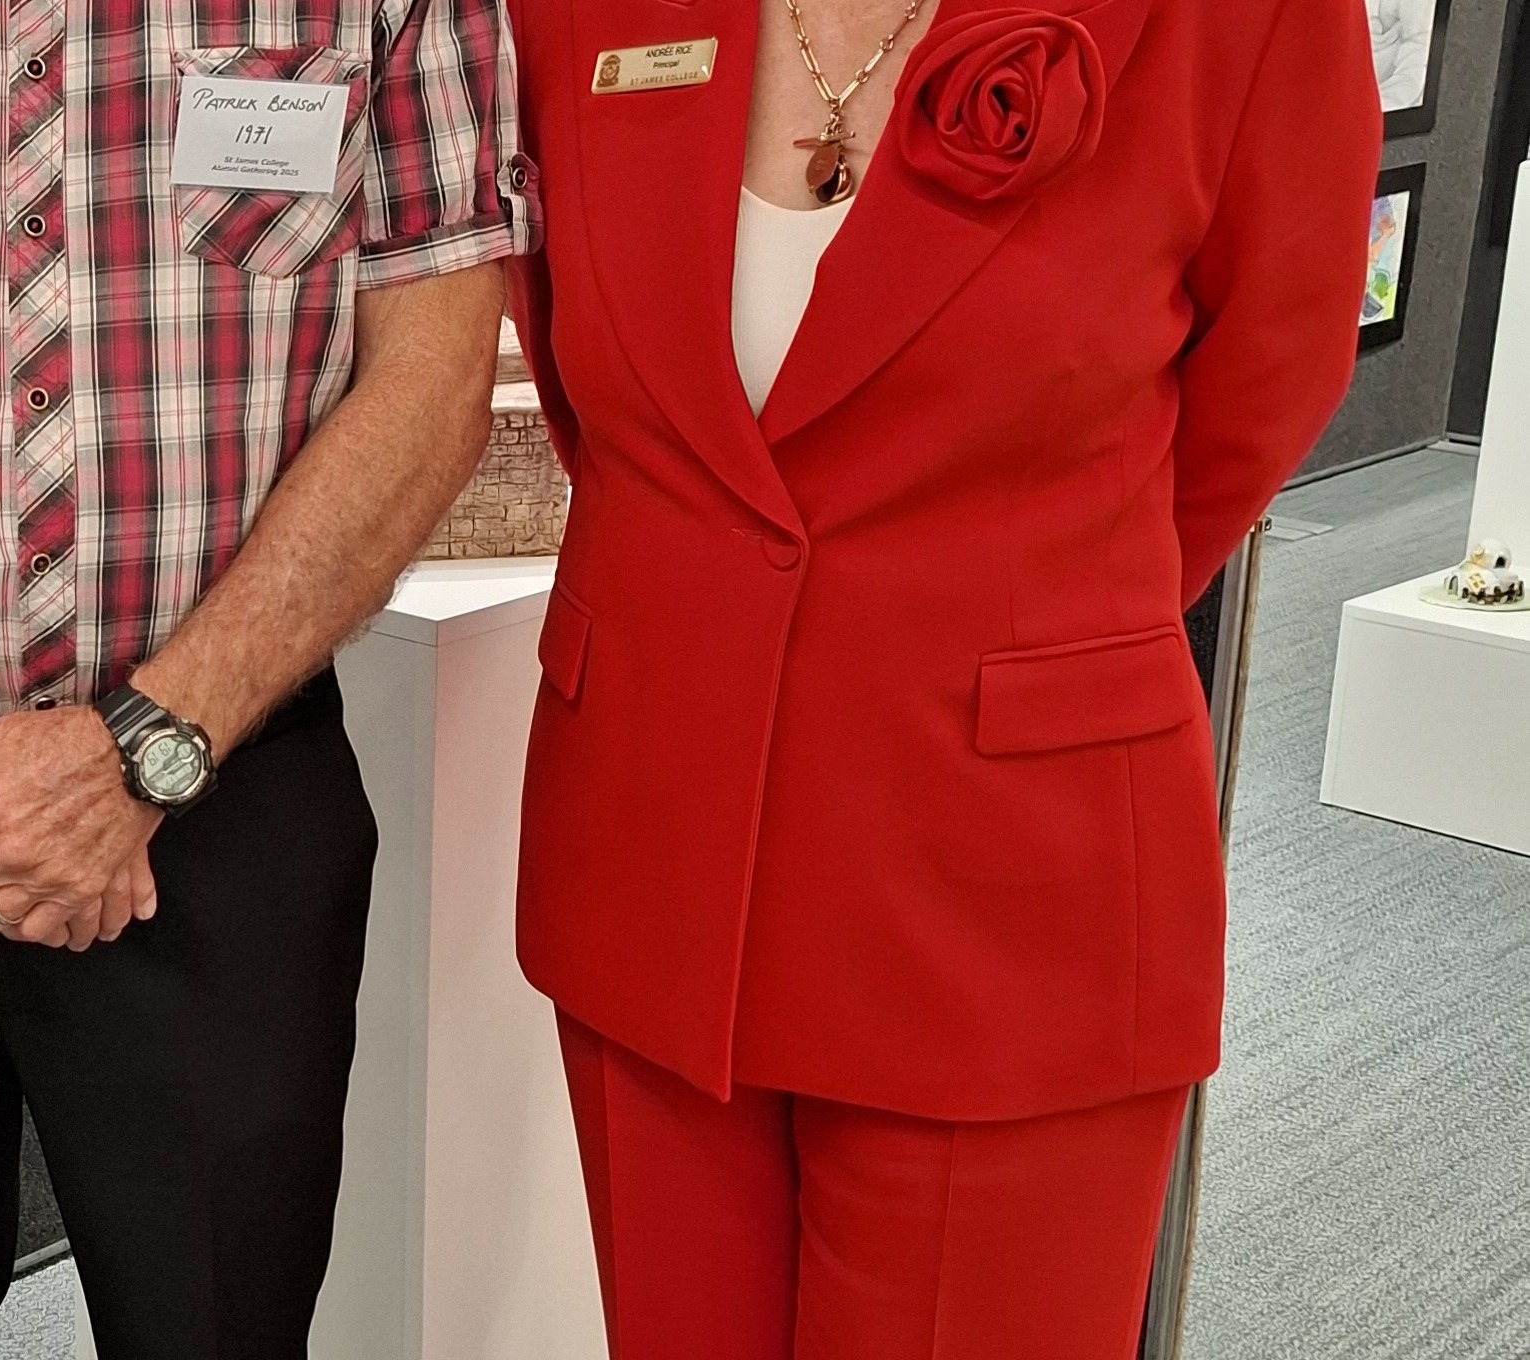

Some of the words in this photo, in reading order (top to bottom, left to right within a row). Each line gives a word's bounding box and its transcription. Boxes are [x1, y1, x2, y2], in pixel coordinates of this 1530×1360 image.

[665, 71, 699, 82] COLLEGE
[192, 88, 257, 112] PATRICK
[267, 90, 331, 112] BENSON
[235, 124, 273, 145] 1971
